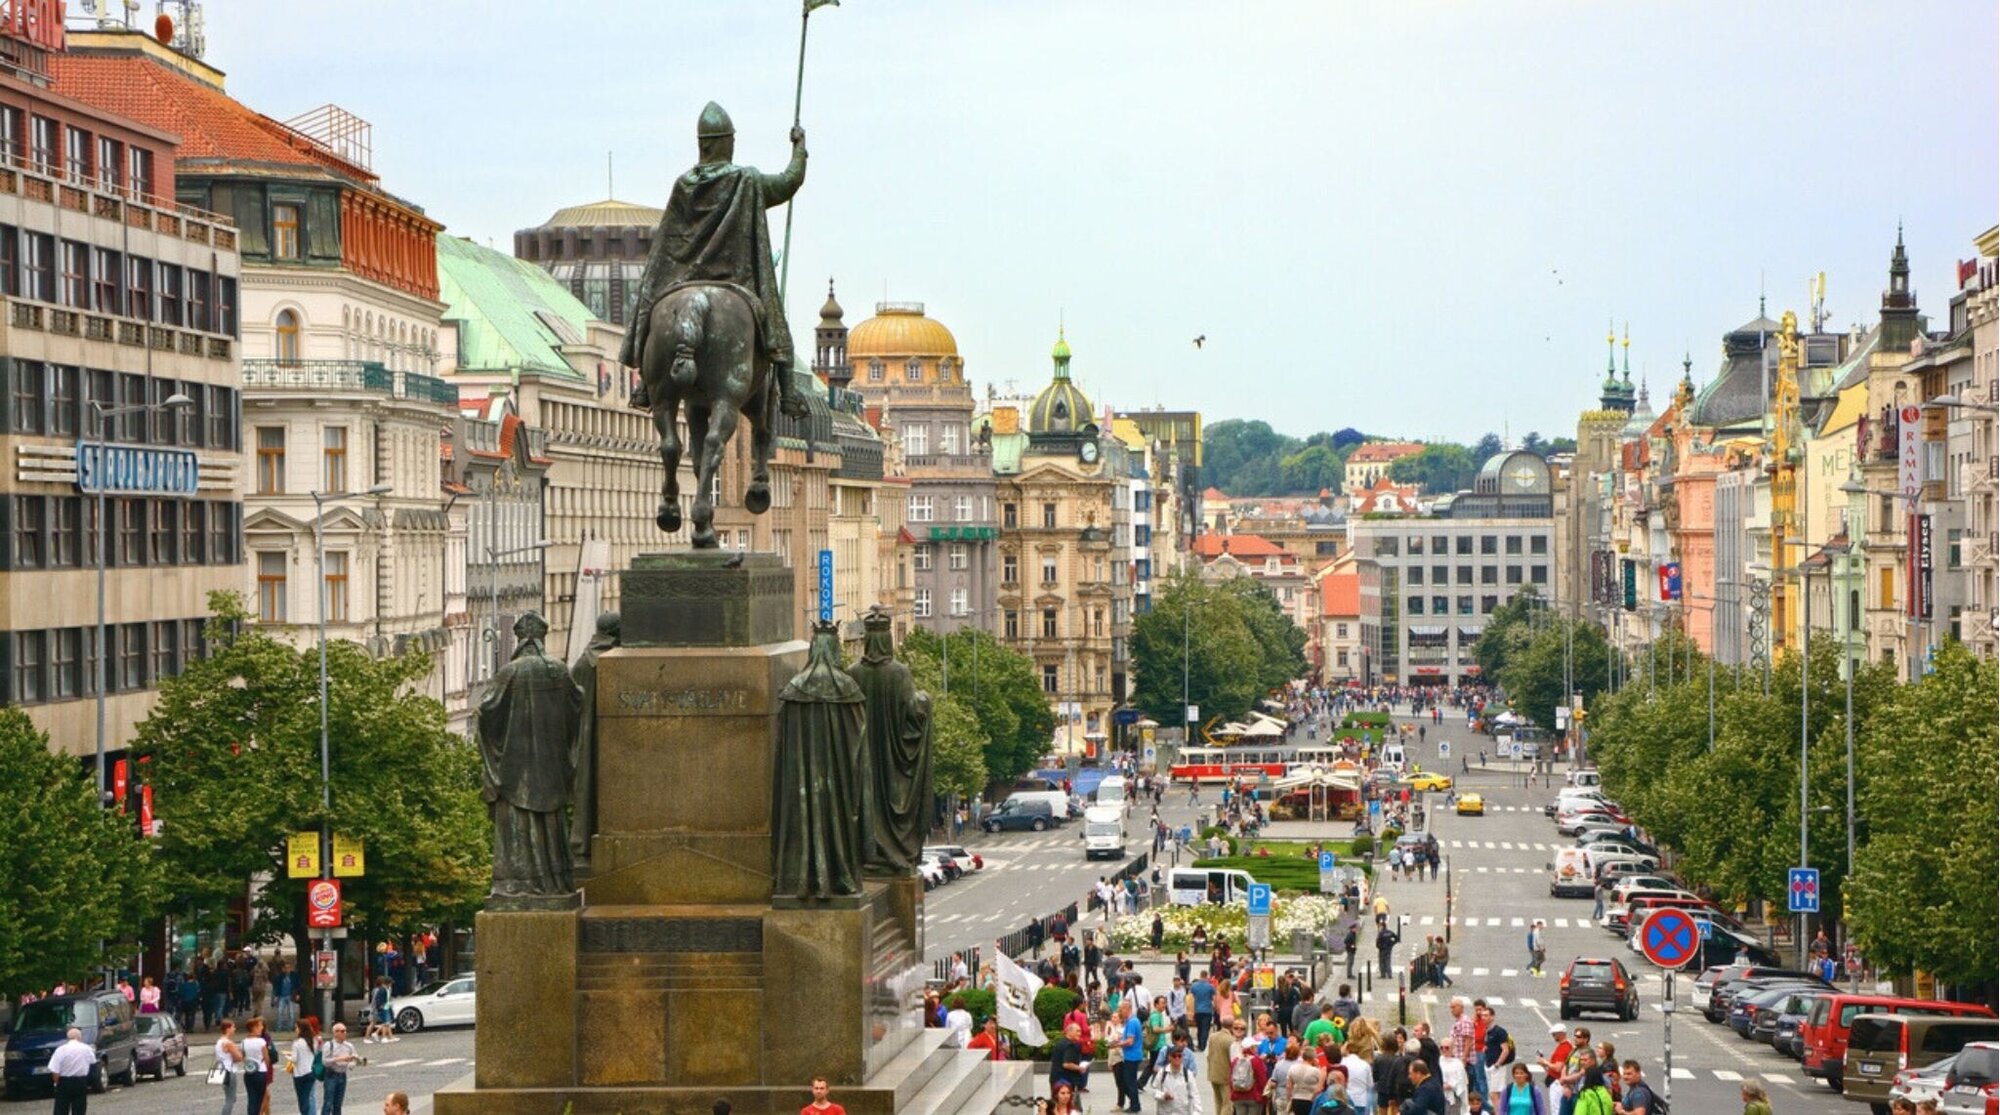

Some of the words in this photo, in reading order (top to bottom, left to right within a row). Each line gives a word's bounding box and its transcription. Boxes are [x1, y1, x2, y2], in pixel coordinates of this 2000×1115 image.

[1905, 432, 1916, 509] RAMADA
[821, 555, 831, 621] ROKOKO
[1323, 854, 1331, 868] P
[1253, 888, 1266, 905] P
